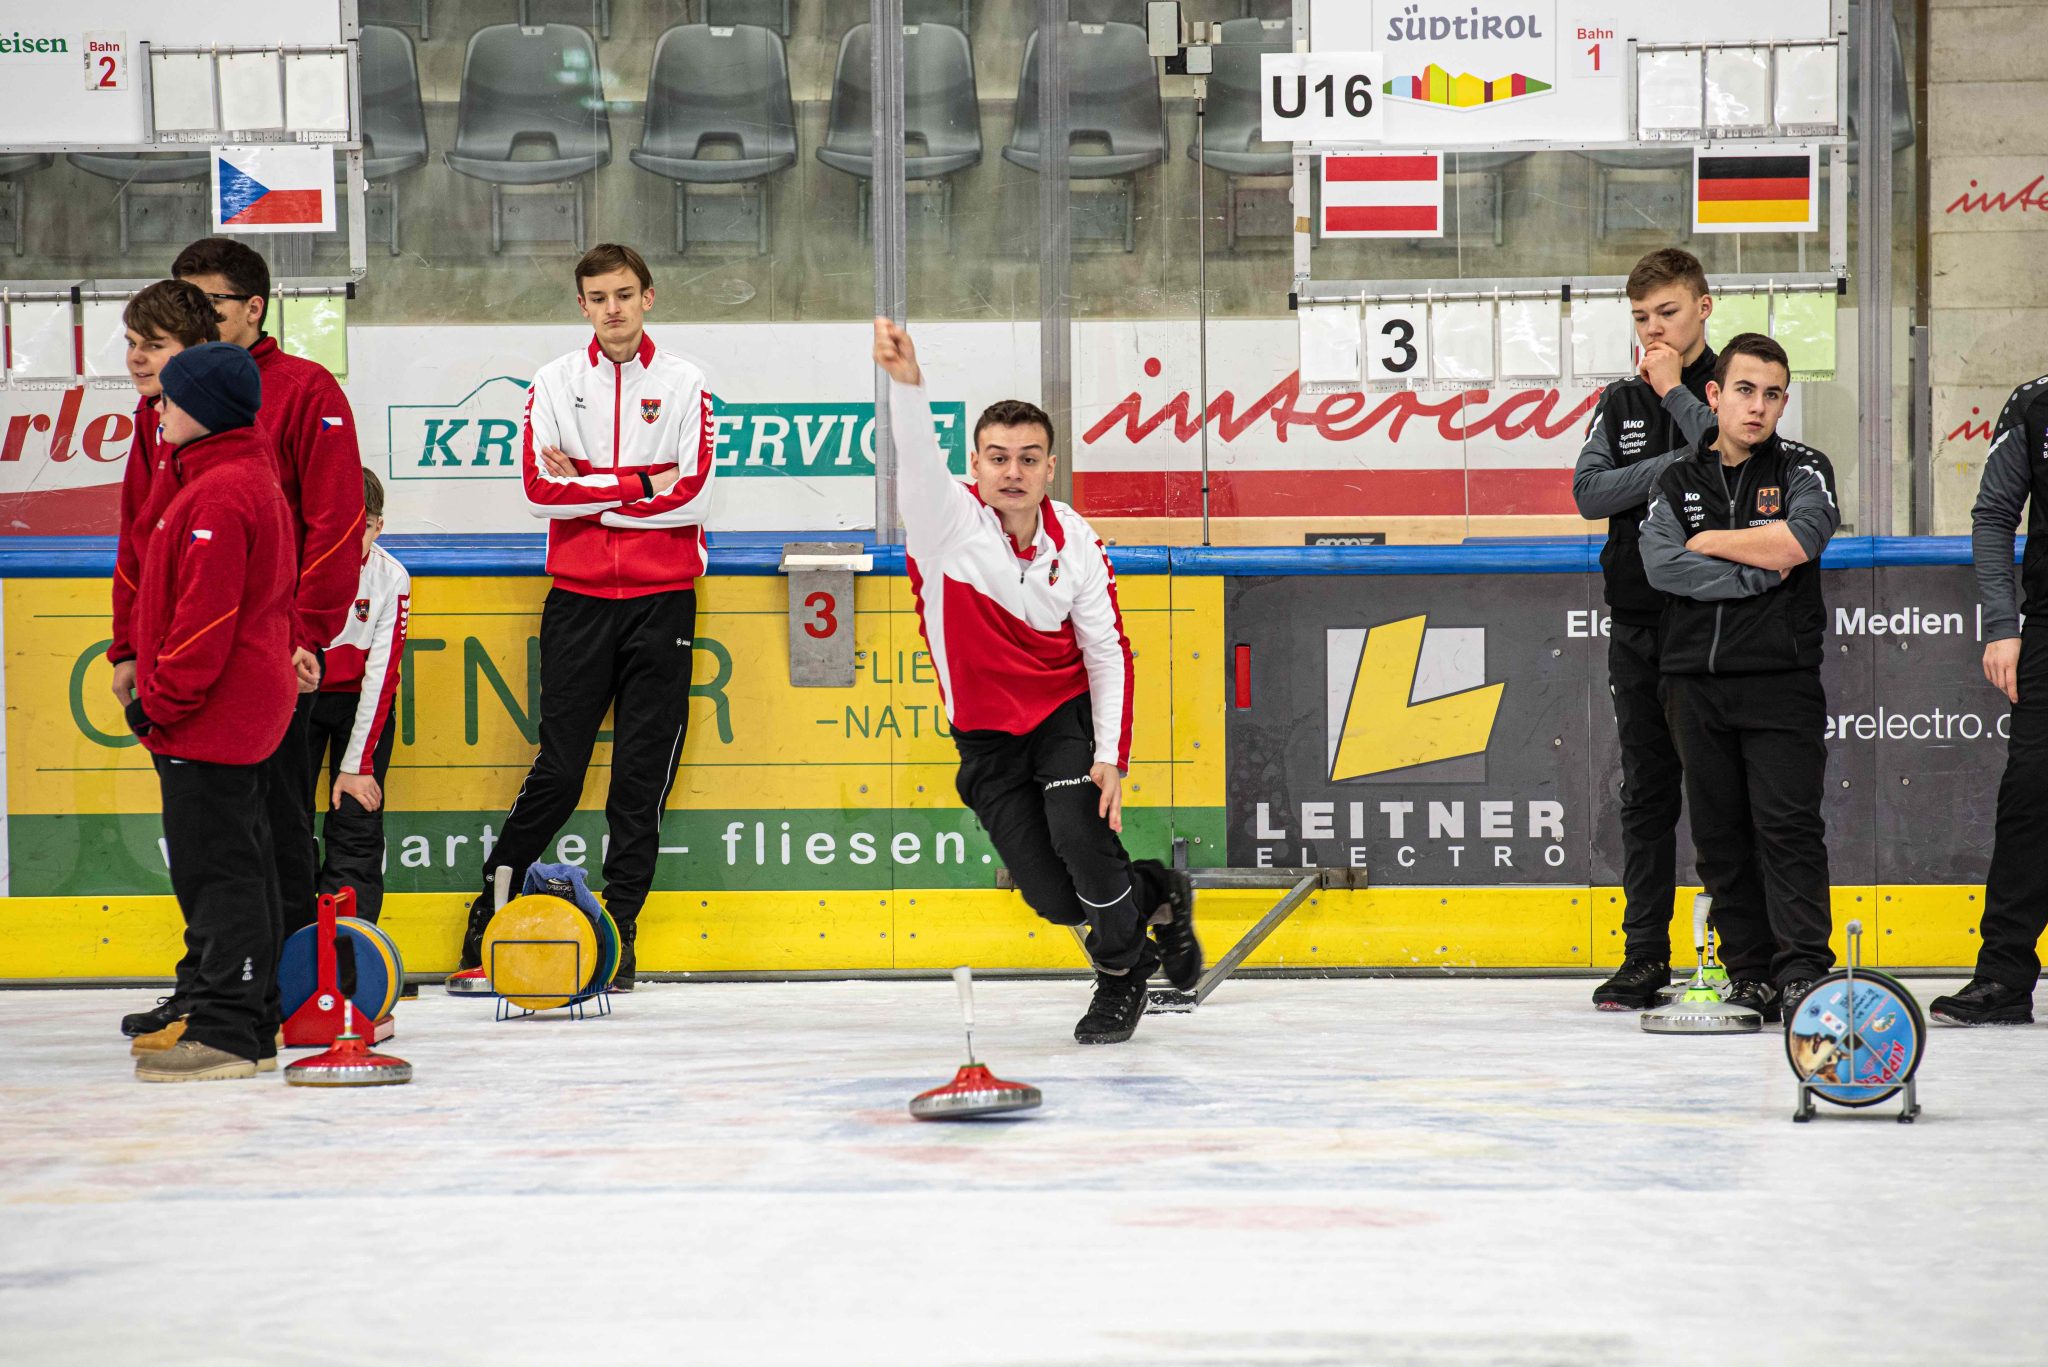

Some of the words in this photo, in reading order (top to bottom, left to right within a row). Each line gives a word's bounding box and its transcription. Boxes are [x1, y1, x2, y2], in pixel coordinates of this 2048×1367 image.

[0, 32, 68, 53] eisen
[89, 42, 120, 52] Bahn
[1577, 28, 1613, 39] Bahn
[99, 56, 117, 87] 2
[1587, 44, 1600, 71] 1
[1272, 74, 1373, 118] U16
[1381, 319, 1417, 373] 3
[804, 591, 838, 639] 3
[1567, 609, 1611, 637] Ele
[1835, 606, 1964, 636] Medien
[1256, 800, 1566, 839] LEITNER
[721, 821, 992, 865] fliesen.
[1256, 844, 1566, 868] ELECTRO
